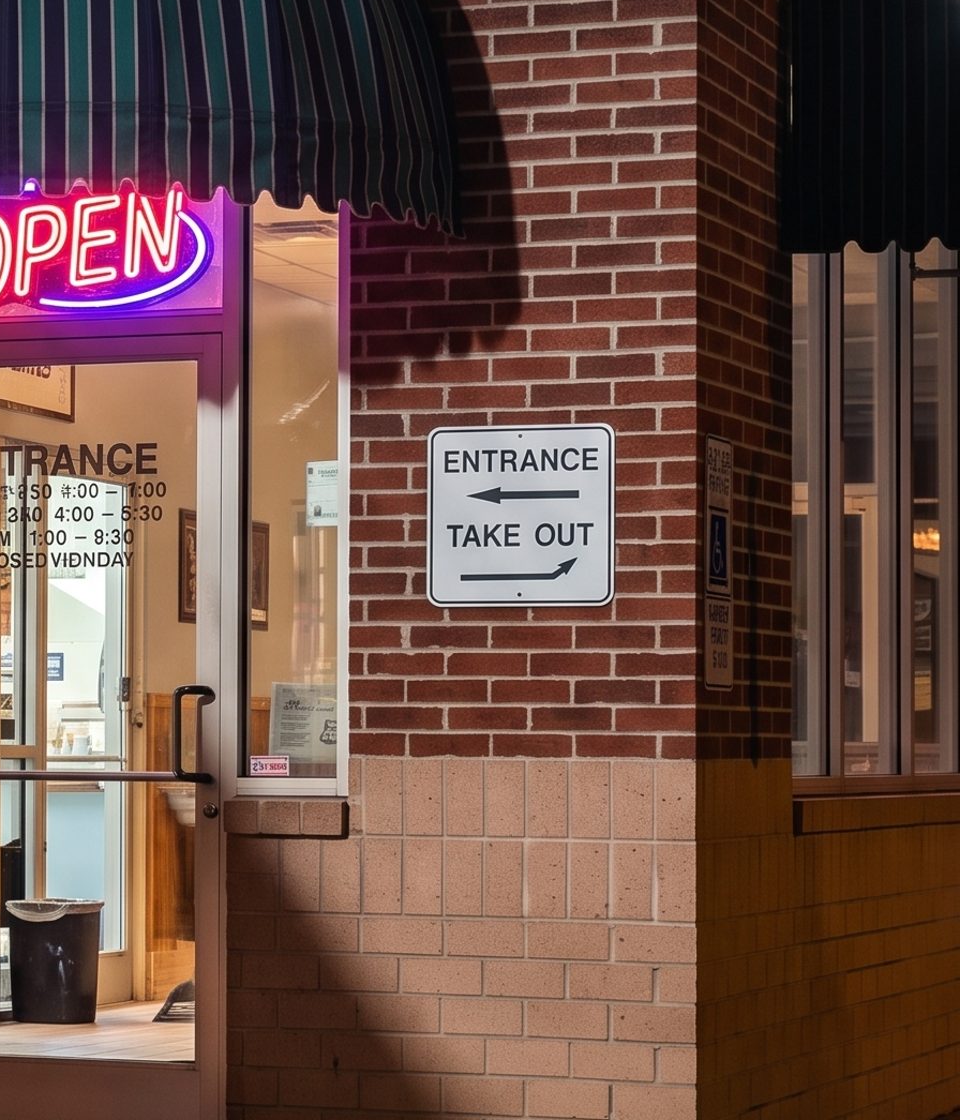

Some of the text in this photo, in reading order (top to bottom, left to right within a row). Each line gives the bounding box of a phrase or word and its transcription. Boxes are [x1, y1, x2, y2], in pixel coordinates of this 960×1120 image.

[444, 447, 599, 473] ENTRANCE
[54, 506, 94, 522] 4:00
[28, 530, 67, 546] 1:00
[94, 529, 135, 545] 8:30
[446, 522, 595, 548] TAKE OUT
